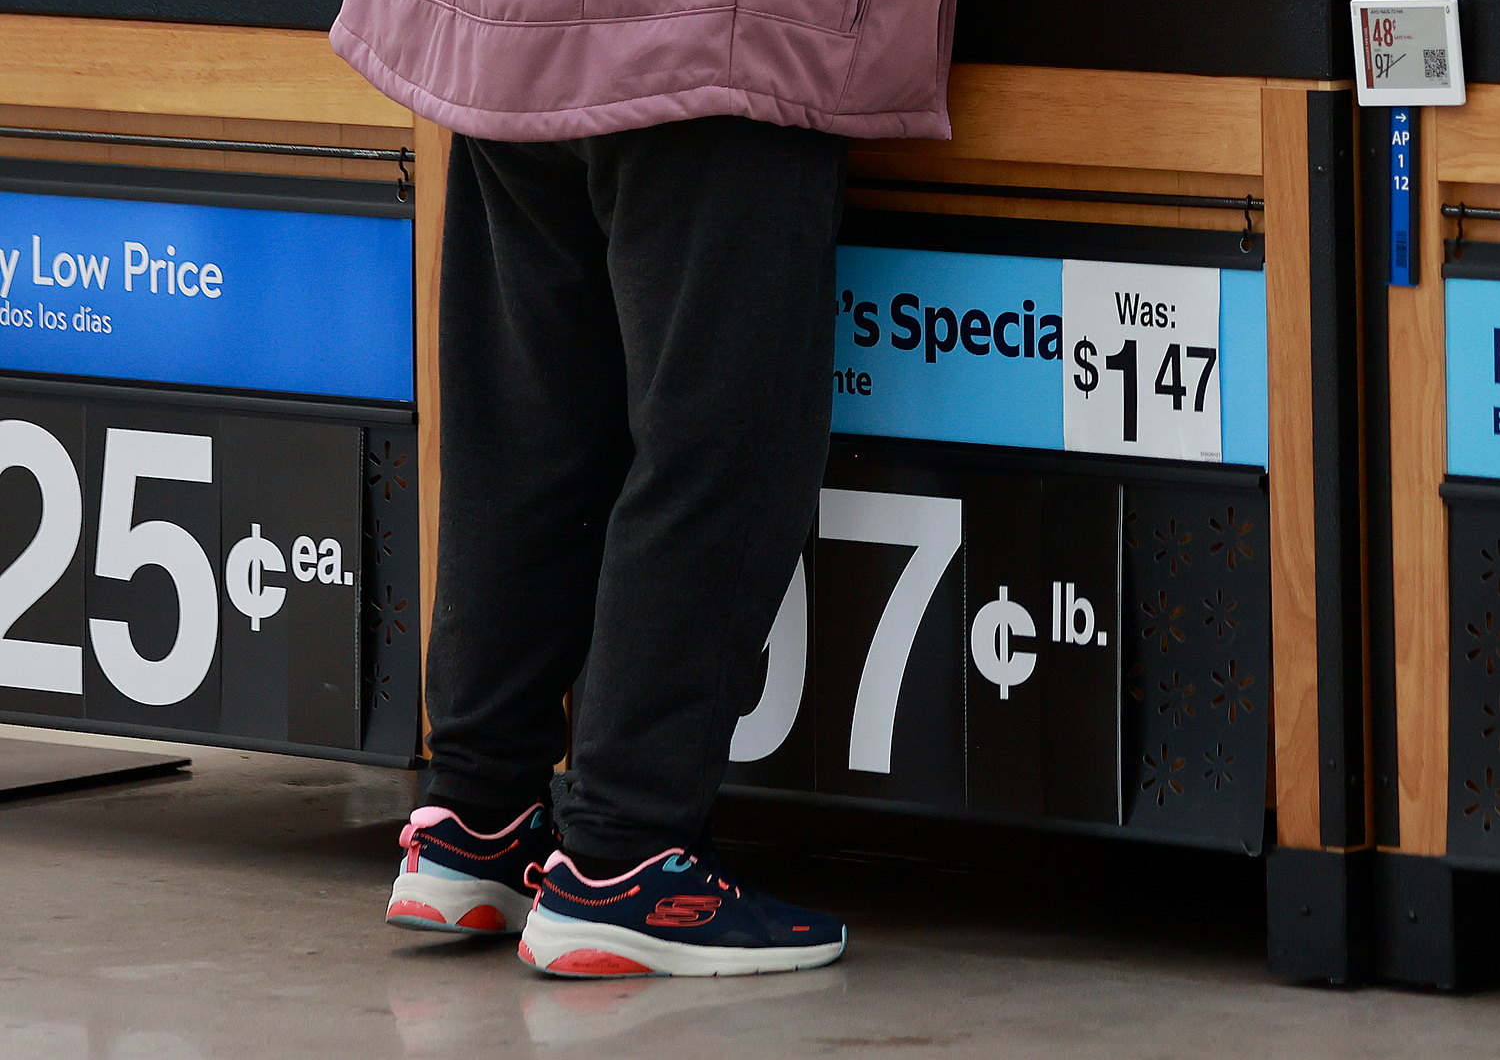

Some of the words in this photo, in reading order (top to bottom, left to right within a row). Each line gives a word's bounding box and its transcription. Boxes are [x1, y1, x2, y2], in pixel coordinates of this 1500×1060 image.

[1392, 130, 1410, 146] AP
[1398, 154, 1404, 169] 1
[1394, 176, 1409, 191] 12
[32, 234, 111, 291] Low
[124, 241, 224, 299] Price
[38, 302, 68, 331] los
[72, 305, 113, 334] días
[890, 293, 1063, 364] Specia
[1115, 292, 1176, 329] Was:
[291, 535, 354, 586] ea.
[1052, 581, 1108, 647] lb.
